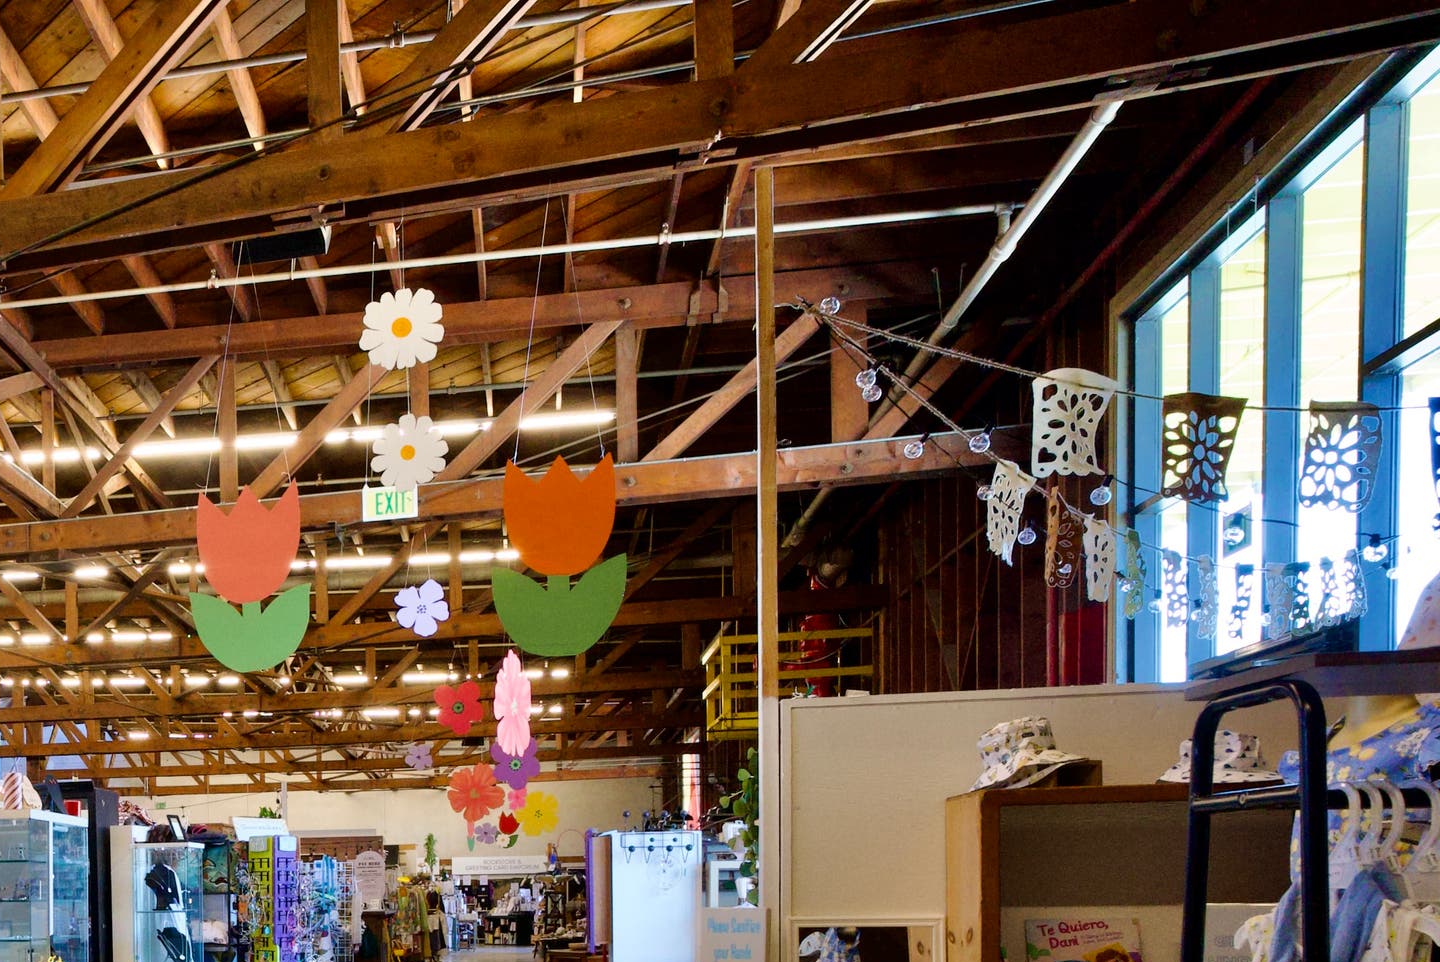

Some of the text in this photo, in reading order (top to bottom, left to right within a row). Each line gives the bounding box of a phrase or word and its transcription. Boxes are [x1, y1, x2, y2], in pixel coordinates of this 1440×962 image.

[375, 491, 406, 515] EXIT
[707, 917, 729, 933] Please
[1037, 921, 1108, 936] Te Quiero,
[713, 944, 752, 962] your Hands
